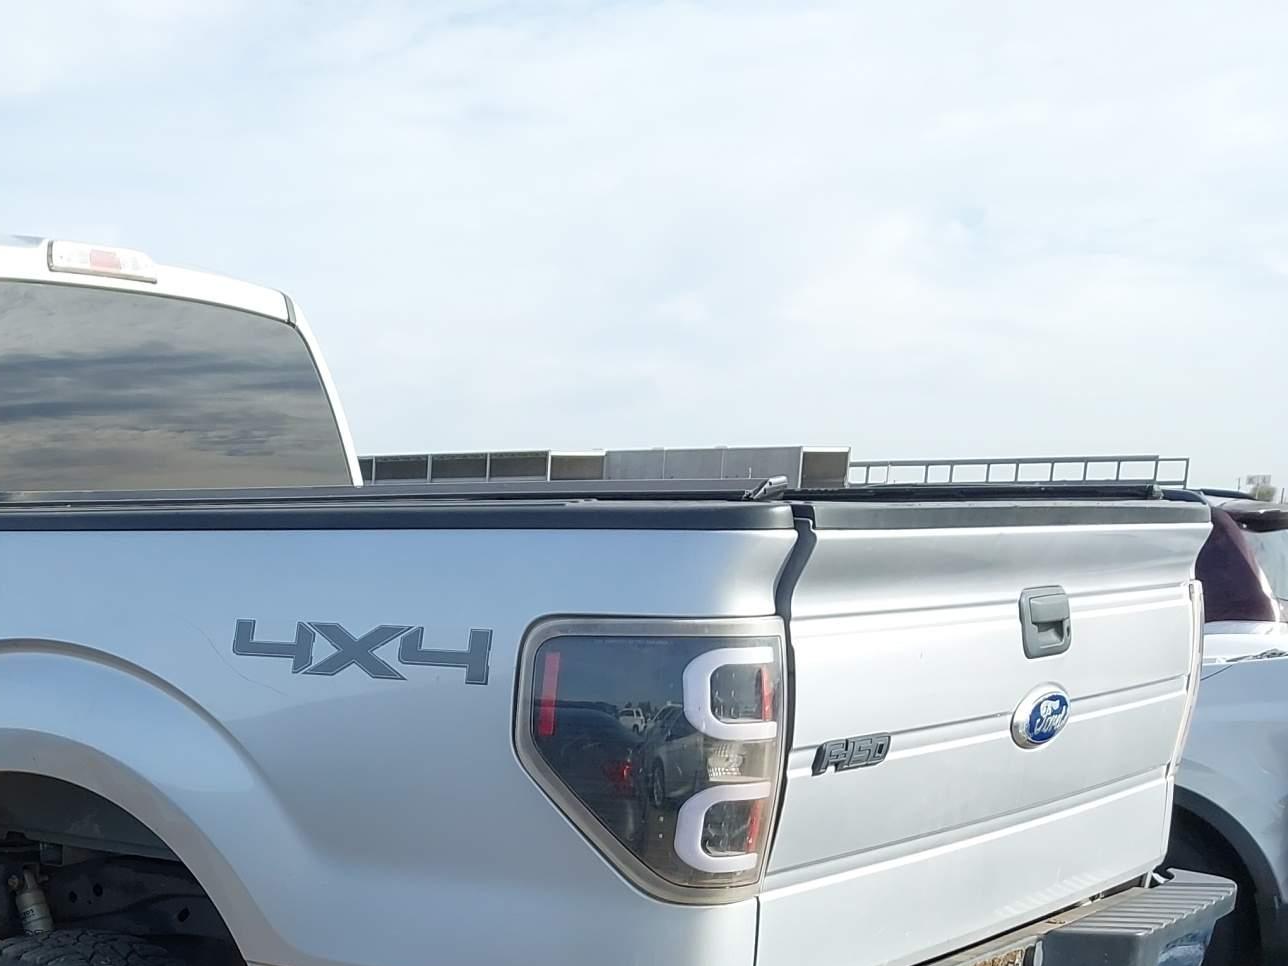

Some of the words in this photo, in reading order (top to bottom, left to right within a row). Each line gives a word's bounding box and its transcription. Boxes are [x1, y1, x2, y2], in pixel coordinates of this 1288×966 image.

[232, 618, 494, 686] 4X4
[1033, 699, 1070, 736] Ford
[811, 732, 892, 777] F-150
